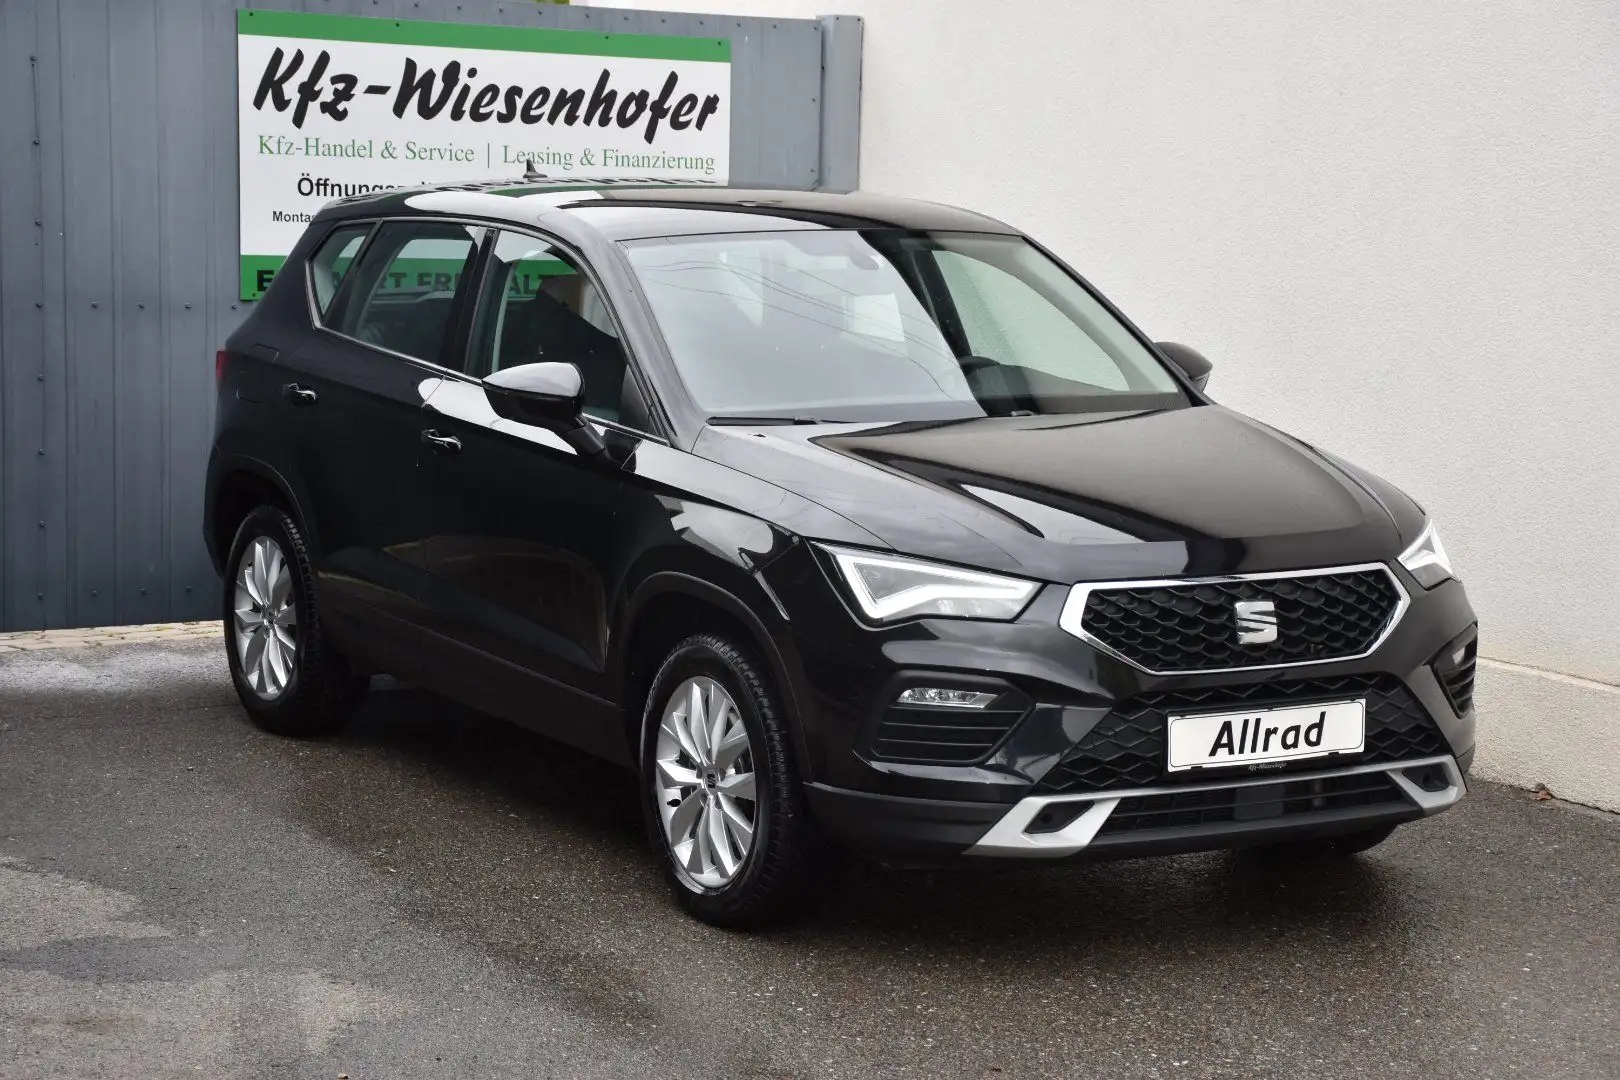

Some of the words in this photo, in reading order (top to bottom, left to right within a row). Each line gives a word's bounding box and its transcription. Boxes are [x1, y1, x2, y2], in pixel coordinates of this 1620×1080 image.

[252, 46, 720, 144] Kfz-Wiesenhofer
[258, 134, 373, 160] Kfz-Handel
[380, 140, 398, 160] &
[405, 141, 475, 162] Service
[503, 145, 573, 170] Leasing
[580, 147, 596, 167] &
[602, 149, 716, 175] Finanzierung
[1208, 711, 1327, 757] Allrad
